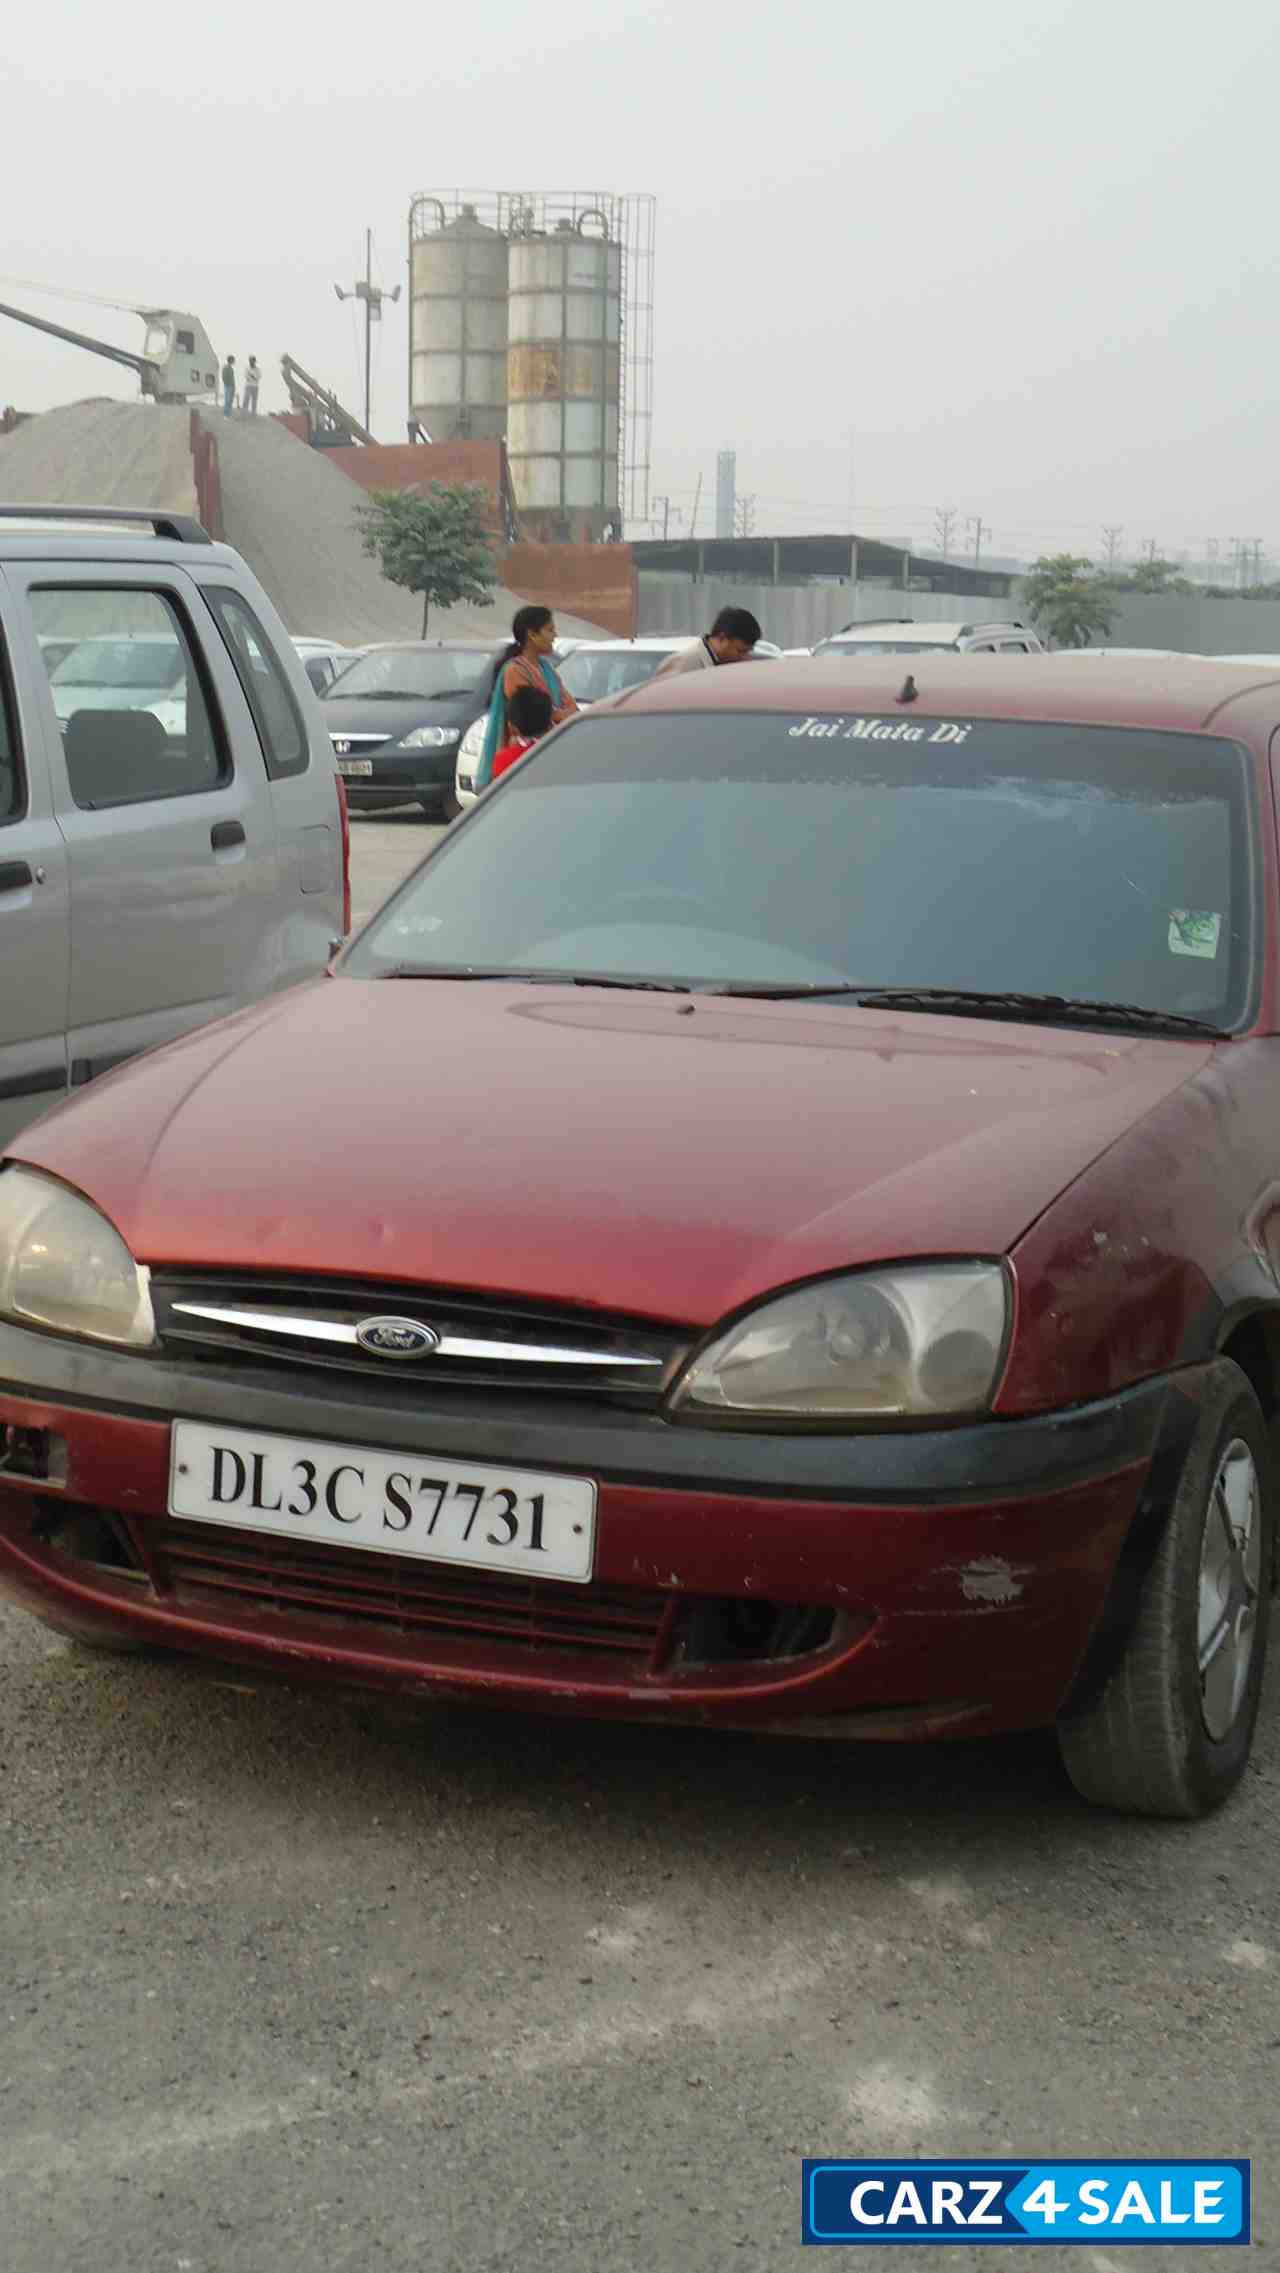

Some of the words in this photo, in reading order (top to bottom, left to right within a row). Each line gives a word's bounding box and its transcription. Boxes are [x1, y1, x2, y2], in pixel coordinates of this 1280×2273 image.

[788, 717, 844, 738] Jai
[844, 719, 925, 741] Mata
[927, 722, 973, 744] Di
[372, 1326, 416, 1348] Ford
[208, 1446, 364, 1525] DL3C
[382, 1471, 548, 1552] S7731
